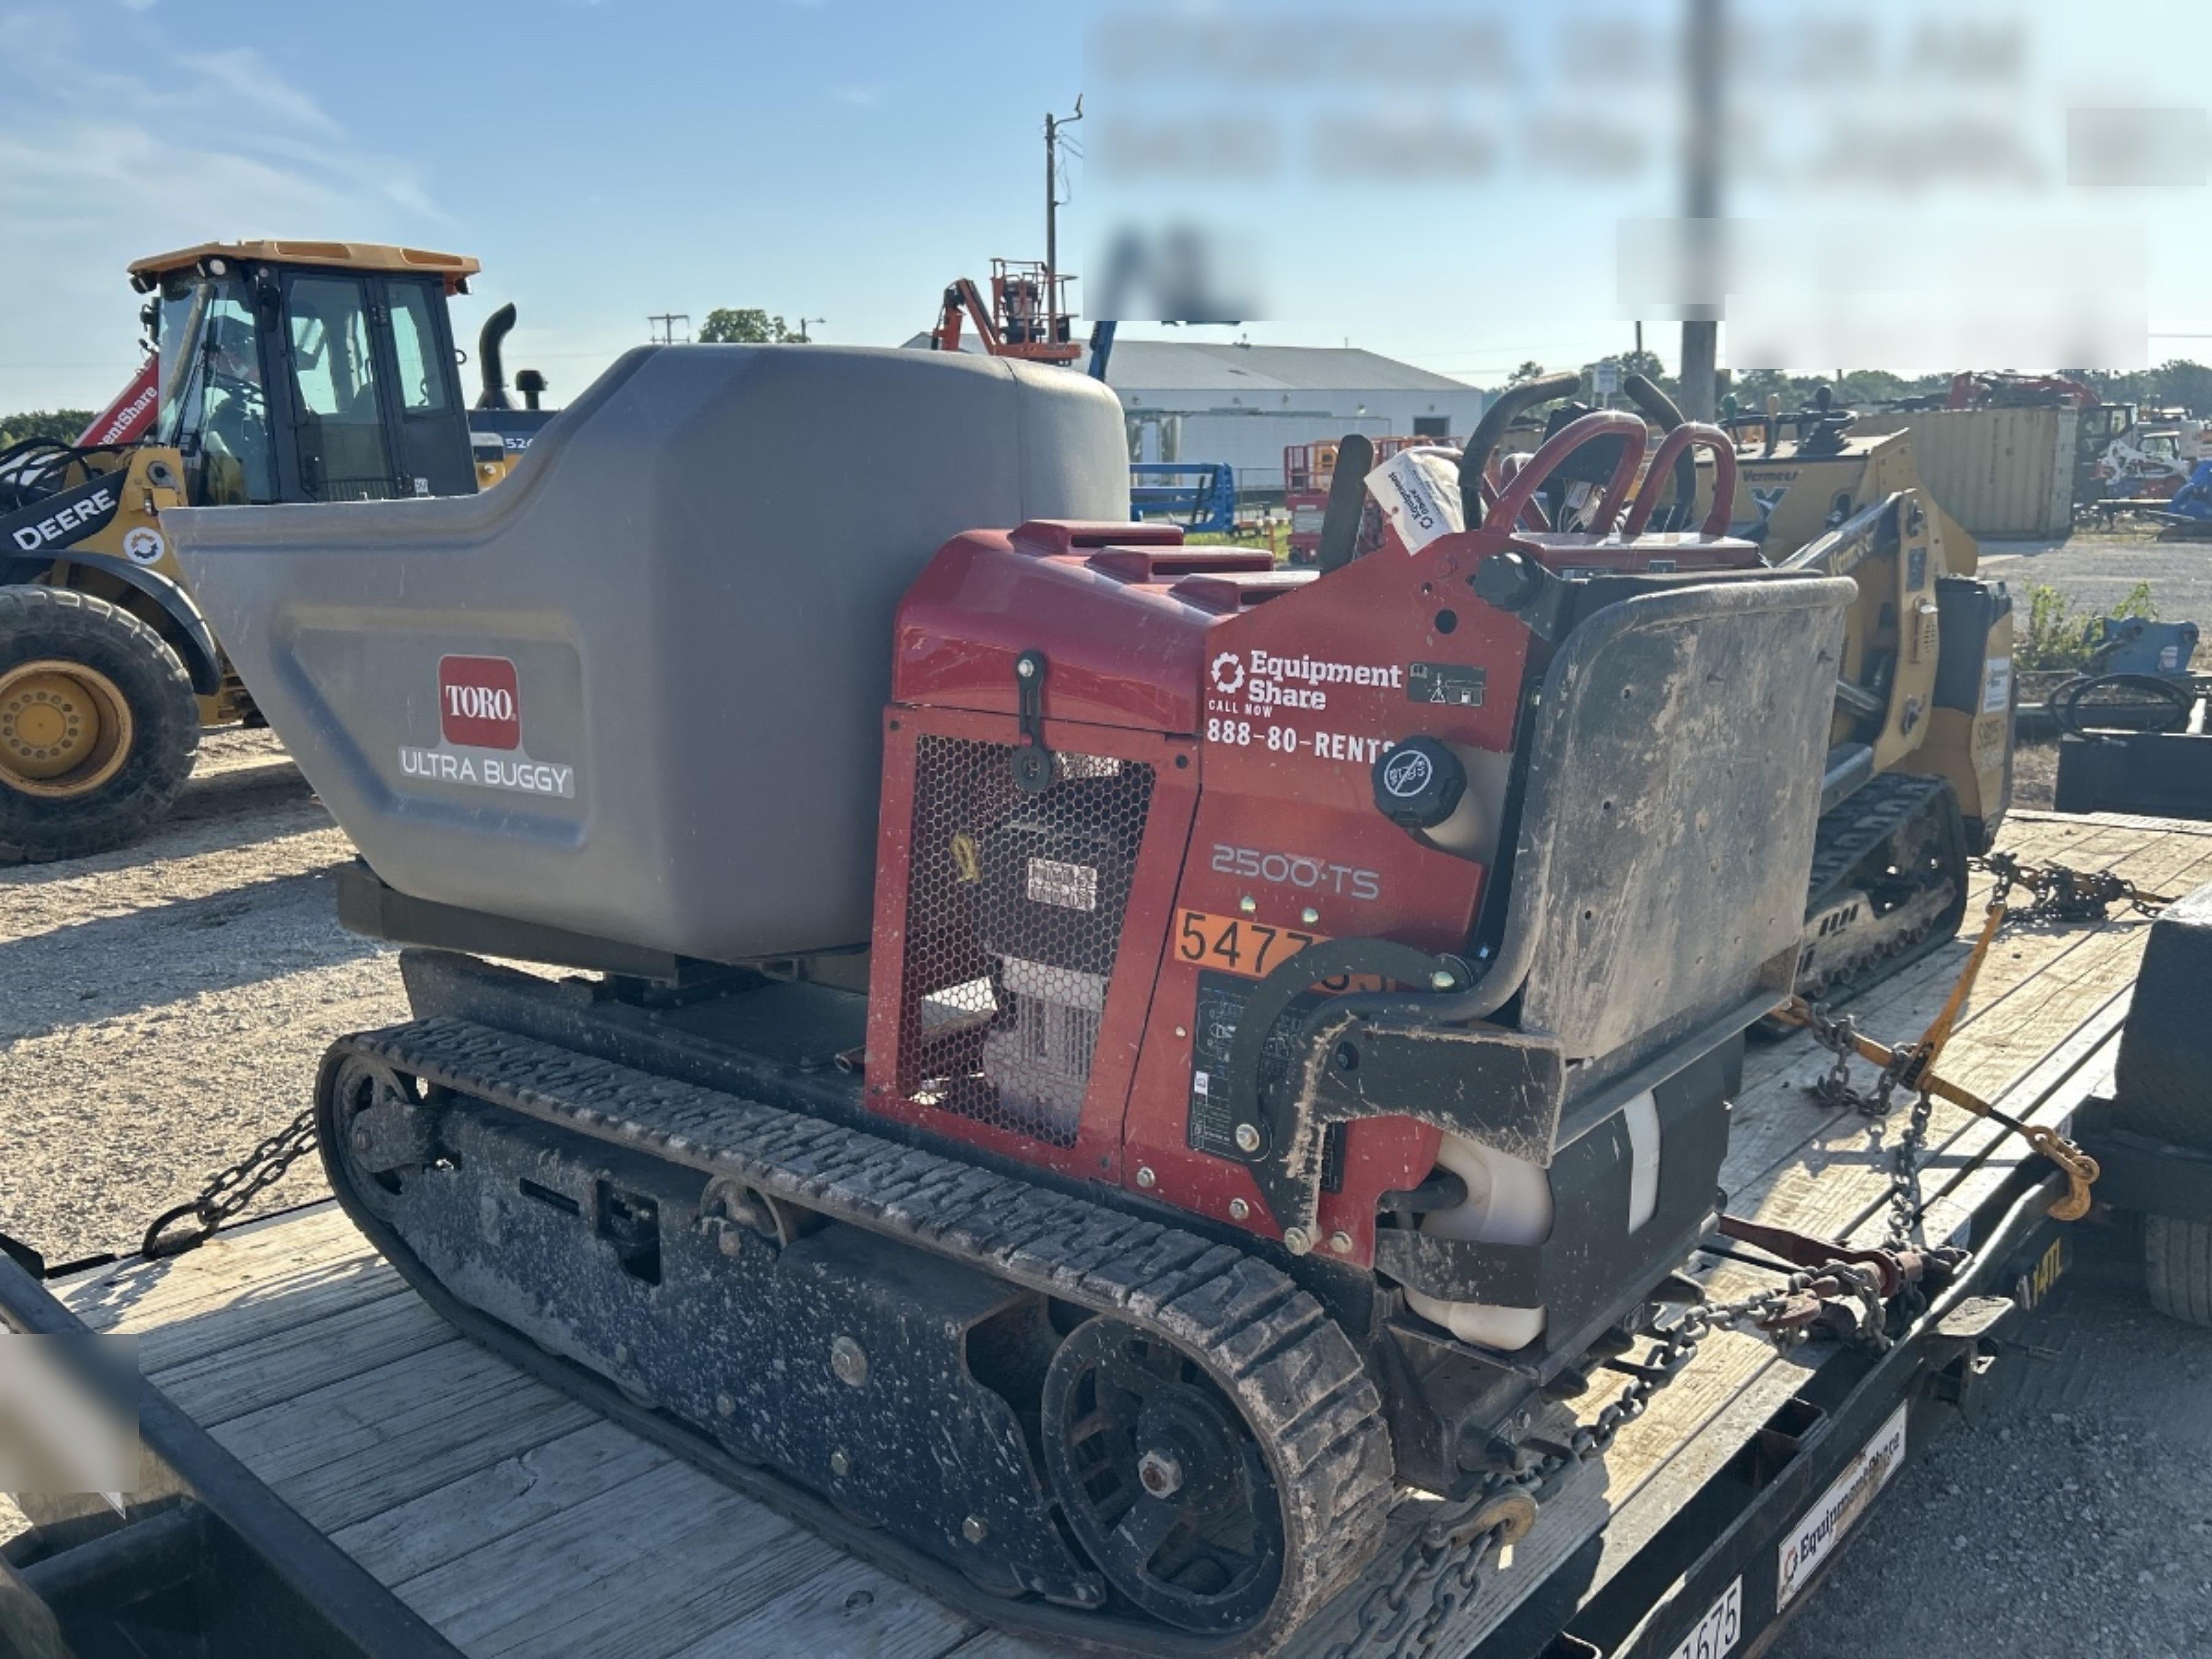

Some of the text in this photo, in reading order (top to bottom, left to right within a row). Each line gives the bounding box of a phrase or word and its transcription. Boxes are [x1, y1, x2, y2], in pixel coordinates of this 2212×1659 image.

[97, 386, 157, 445] entShare
[12, 488, 117, 551] DEERE
[1249, 649, 1403, 689] Equipment
[445, 684, 513, 721] TORO
[1208, 699, 1273, 718] CALL NOW
[1247, 678, 1327, 710] Share
[401, 750, 568, 794] ULTRA BUGGY
